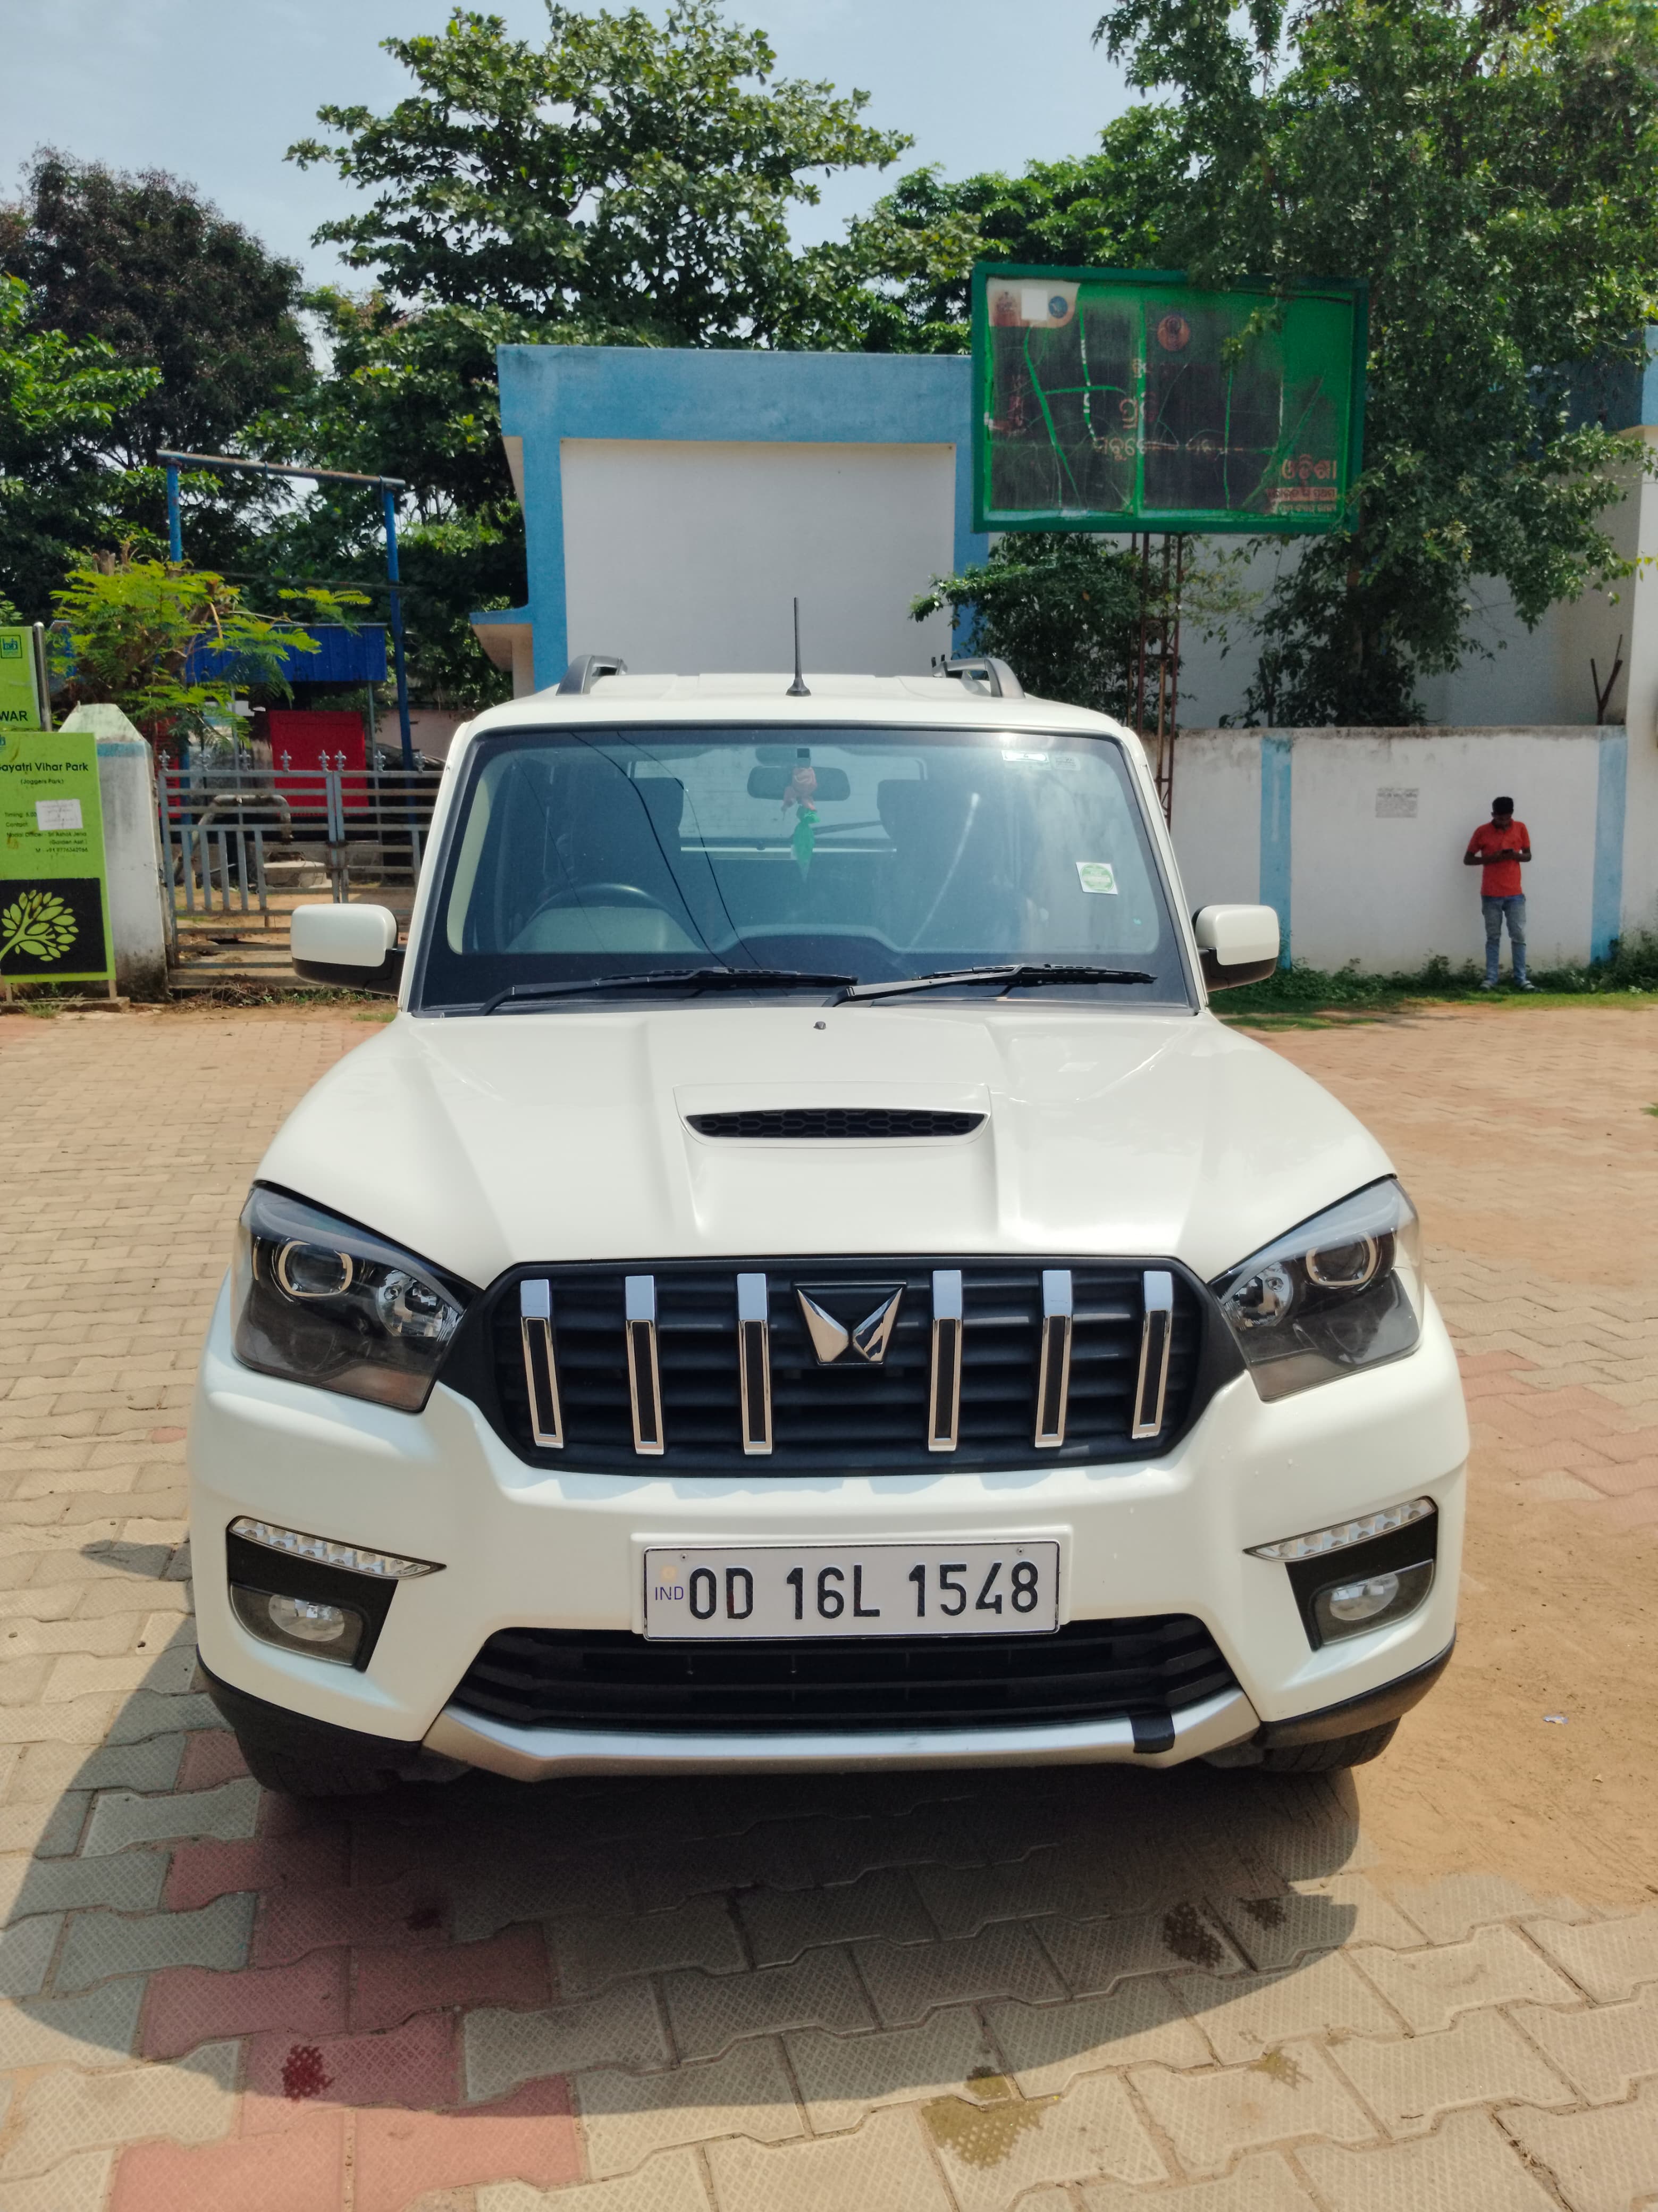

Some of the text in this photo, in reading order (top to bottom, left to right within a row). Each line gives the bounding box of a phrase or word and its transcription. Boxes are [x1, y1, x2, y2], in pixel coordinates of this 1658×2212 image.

[0, 762, 89, 773] ayatri Vihar Park
[655, 1586, 684, 1601] IND
[689, 1560, 1039, 1621] OD 16L 1548
